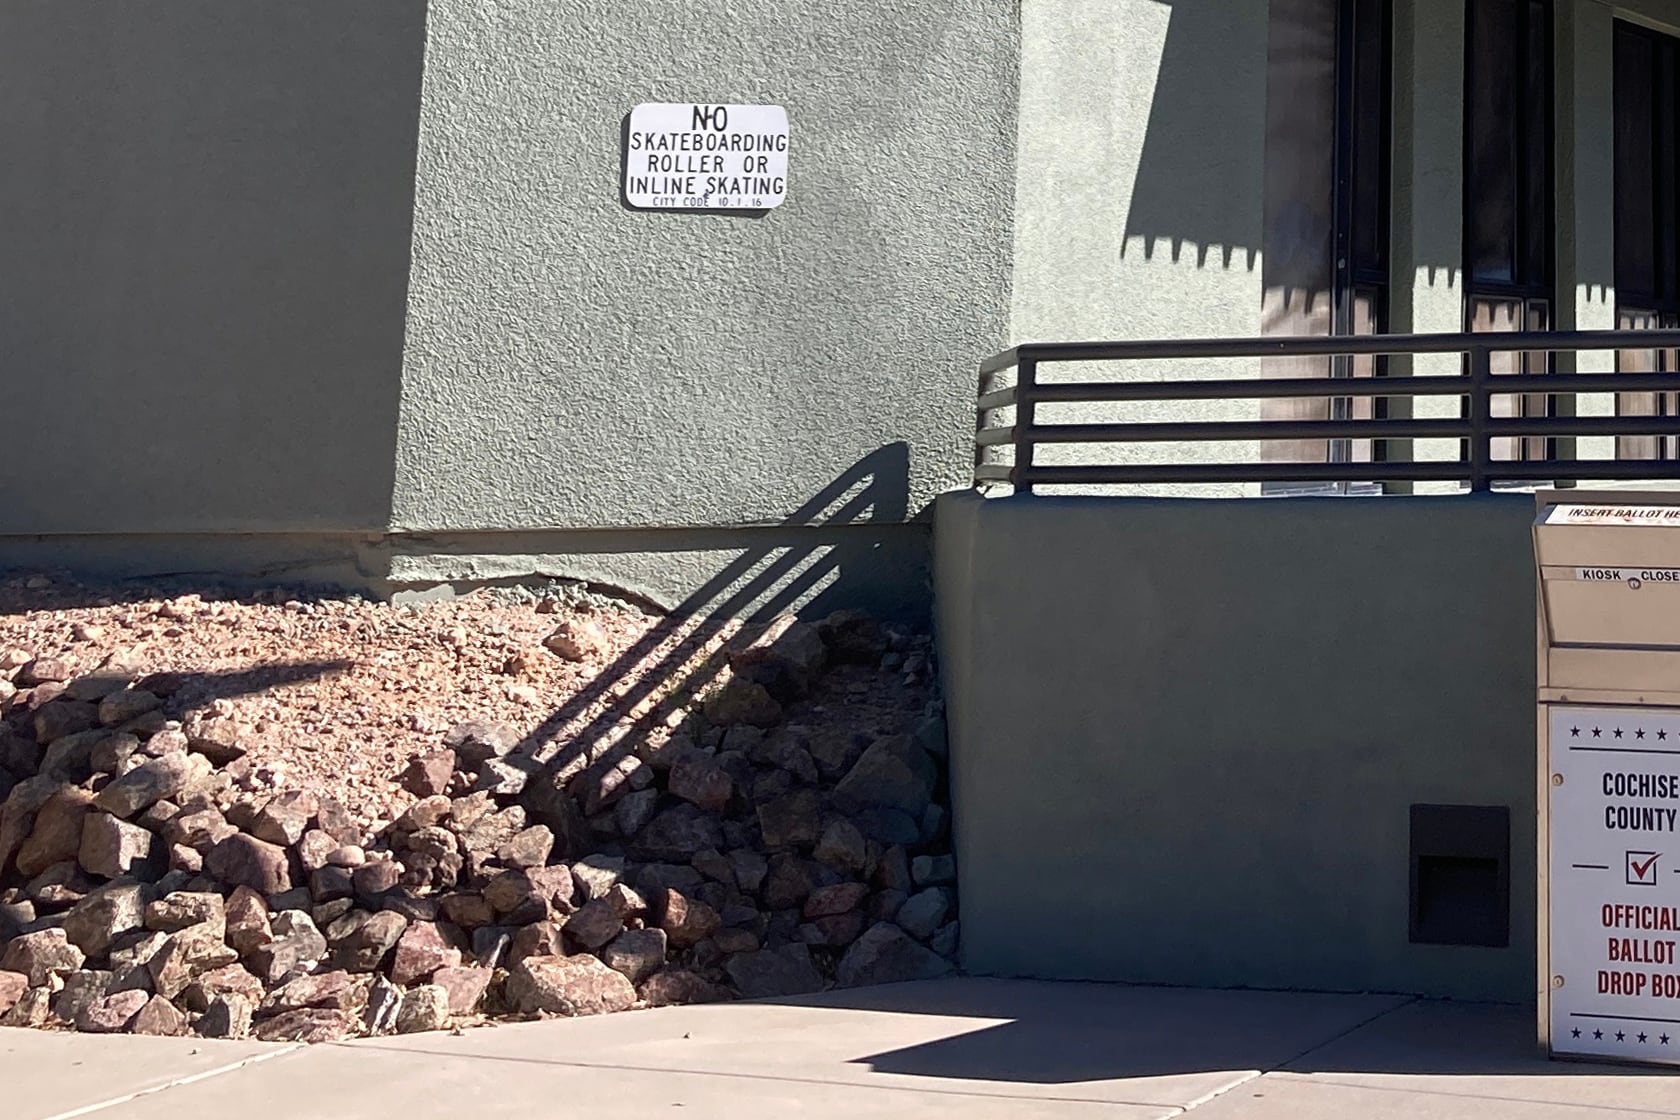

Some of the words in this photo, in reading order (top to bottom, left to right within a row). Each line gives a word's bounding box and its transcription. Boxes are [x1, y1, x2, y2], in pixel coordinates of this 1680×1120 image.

[692, 105, 728, 132] NO
[630, 132, 787, 152] SKATEBOARDING
[648, 154, 724, 174] ROLLER
[743, 155, 768, 174] OR
[630, 176, 696, 195] INLINE
[705, 176, 784, 195] SKATING
[653, 197, 676, 207] CITY
[683, 196, 709, 208] CODE
[1568, 508, 1614, 518] INSERT
[1613, 509, 1664, 519] BALLOT
[1583, 570, 1621, 580] KIOSK
[1602, 772, 1679, 799] COCHISE
[1605, 806, 1677, 832] COUNTY
[1608, 937, 1676, 965] BALLOT
[1598, 970, 1647, 996] DROP
